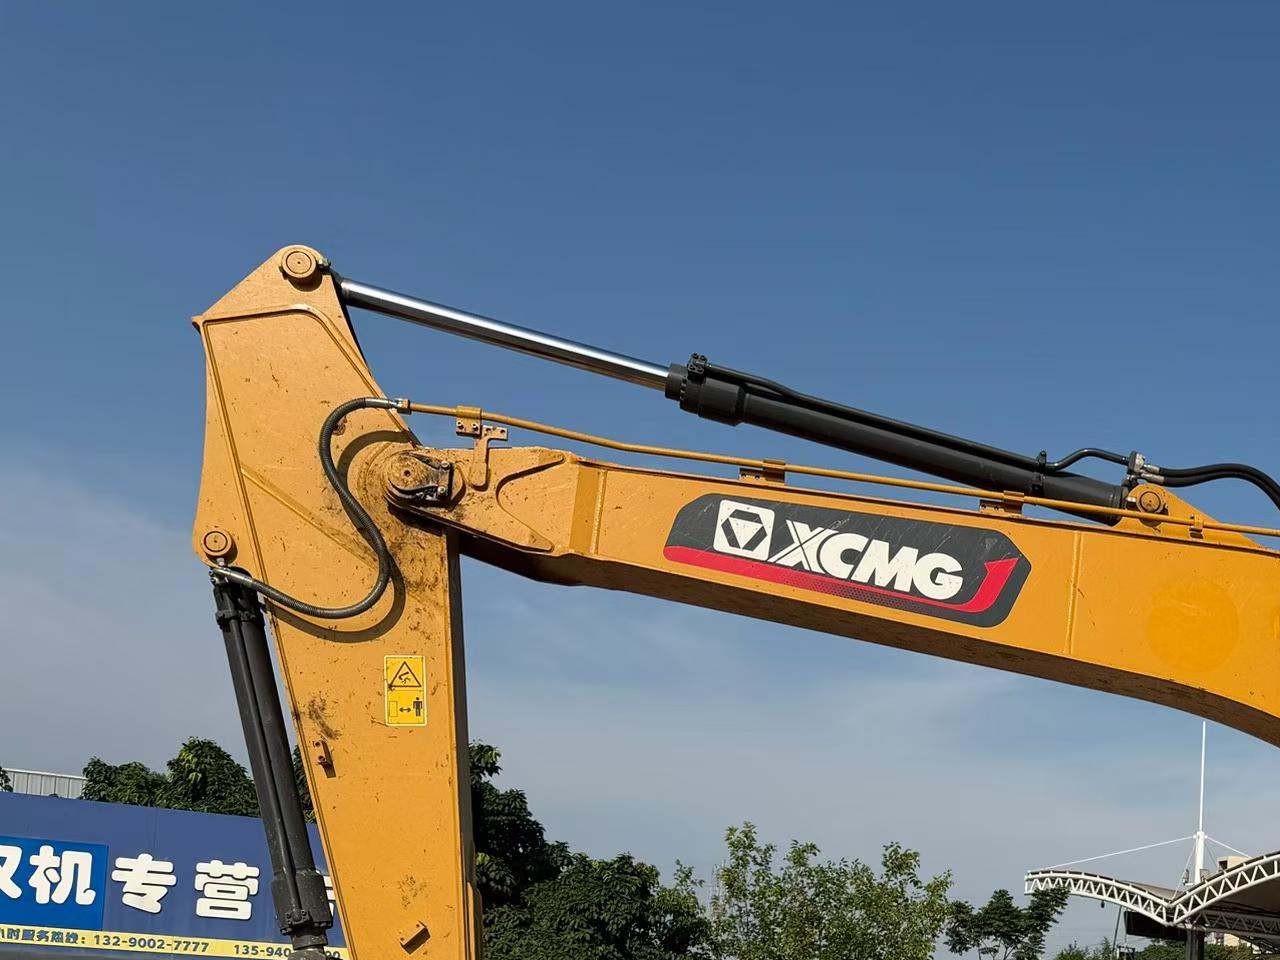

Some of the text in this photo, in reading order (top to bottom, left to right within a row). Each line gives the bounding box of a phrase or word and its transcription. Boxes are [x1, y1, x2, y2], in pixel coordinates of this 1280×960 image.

[767, 519, 964, 600] XCMG
[0, 845, 336, 921] 机专营
[93, 934, 209, 953] 132-9002-7777
